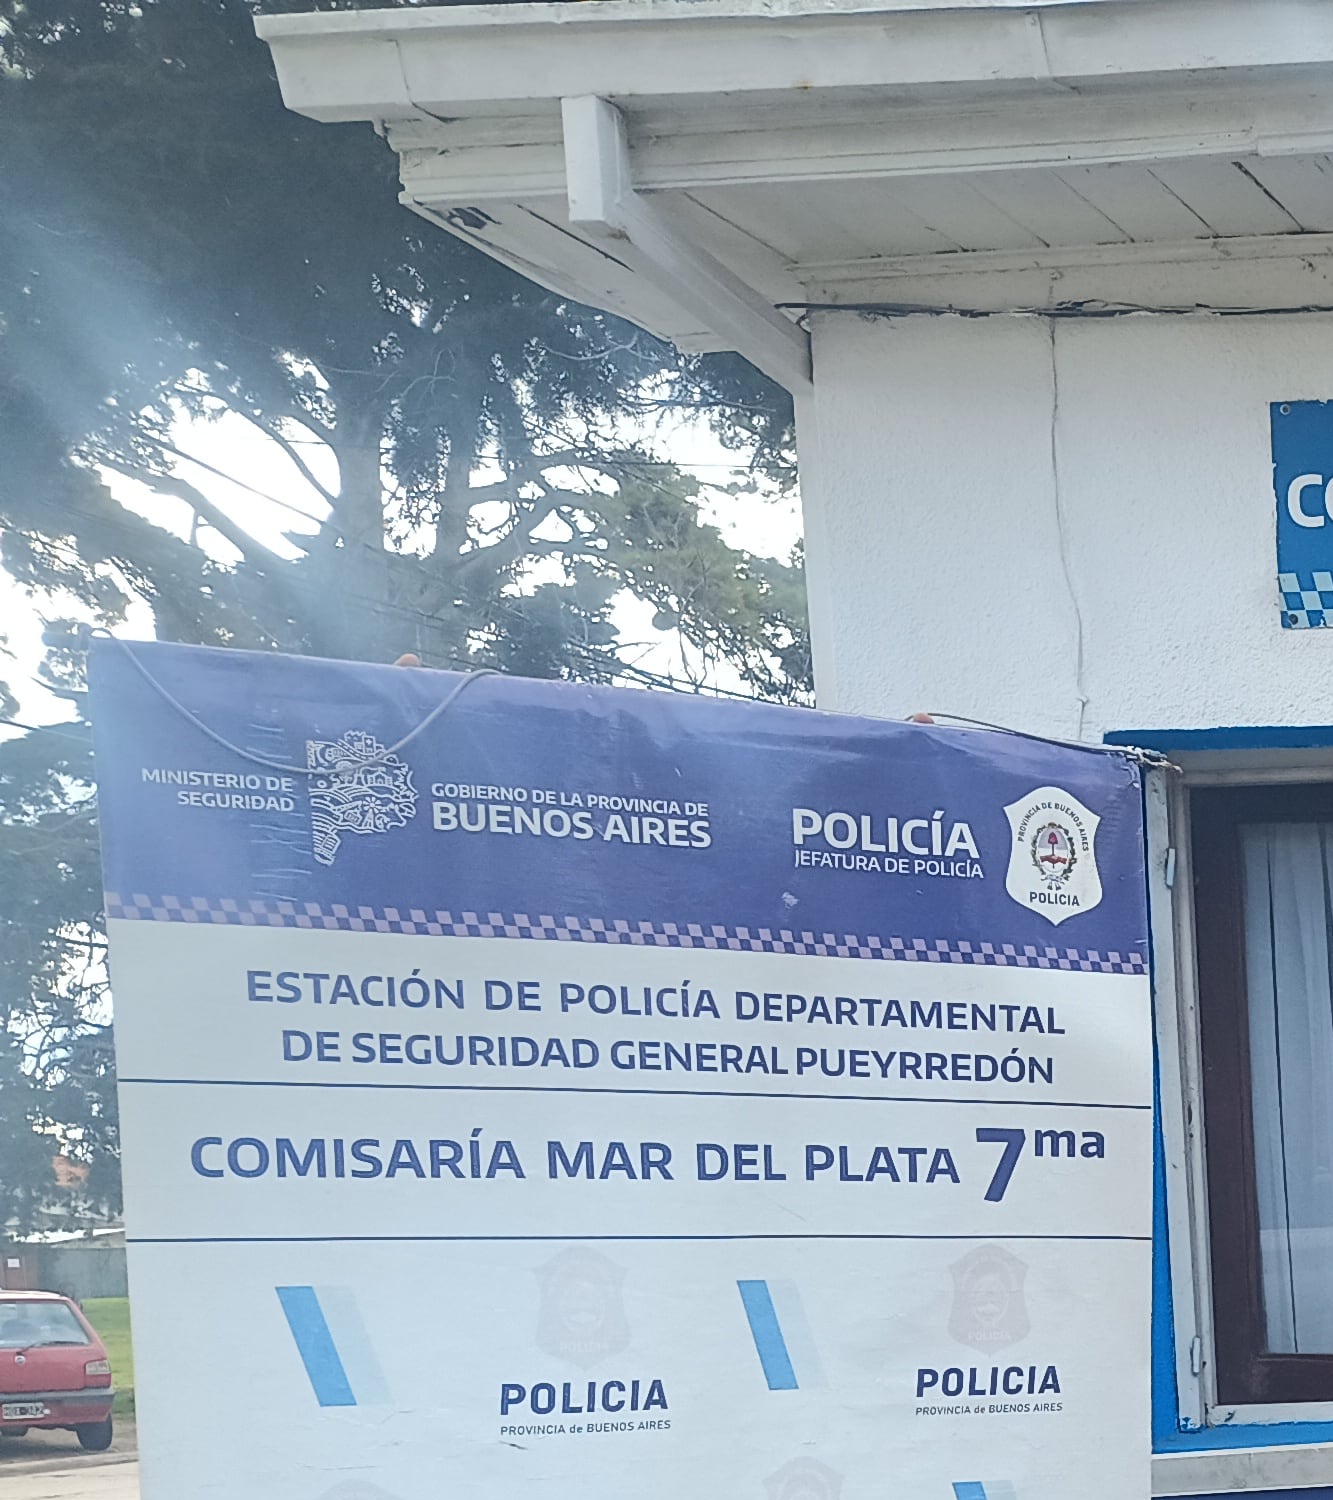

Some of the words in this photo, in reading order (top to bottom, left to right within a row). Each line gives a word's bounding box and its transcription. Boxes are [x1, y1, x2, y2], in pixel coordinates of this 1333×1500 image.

[141, 767, 261, 790] MINISTERIO
[264, 776, 294, 792] DE
[176, 790, 295, 812] SEGURIDAD
[431, 782, 528, 802] GOBIERNO
[531, 789, 557, 805] DE
[559, 791, 584, 808] LA
[586, 794, 682, 815] PROVINCIA
[684, 802, 709, 817] DE
[432, 801, 594, 840] BUENOS
[603, 816, 713, 849] AIRES
[792, 808, 980, 859] POLICÍA
[794, 849, 882, 872] JEFATURA
[884, 857, 910, 874] DE
[914, 856, 985, 879] POLICÍA
[1029, 891, 1080, 907] POLICIA
[246, 968, 465, 1010] ESTACIÓN
[484, 980, 542, 1012] DE
[559, 979, 721, 1019] POLICÍA
[735, 991, 1066, 1035] DEPARTAMENTAL
[282, 1029, 341, 1063] DE
[351, 1032, 600, 1069] SEGURIDAD
[610, 1040, 789, 1075] GENERAL
[796, 1047, 1053, 1085] PUEYRREDÓN
[190, 1127, 527, 1179] COMISARÍA
[547, 1140, 675, 1181] MAR
[696, 1143, 787, 1181] DEL
[805, 1144, 961, 1184] PLATA
[500, 1379, 669, 1416] POLICIA
[916, 1365, 1061, 1398] POLICIA
[915, 1405, 971, 1416] PROVINCIA
[973, 1405, 986, 1414] de
[988, 1403, 1031, 1414] BUENOS
[1032, 1402, 1063, 1413] AIRES
[500, 1424, 566, 1436] PROVINCIA
[569, 1423, 584, 1434] de
[586, 1421, 635, 1433] BUENOS
[637, 1419, 671, 1431] AIRES
